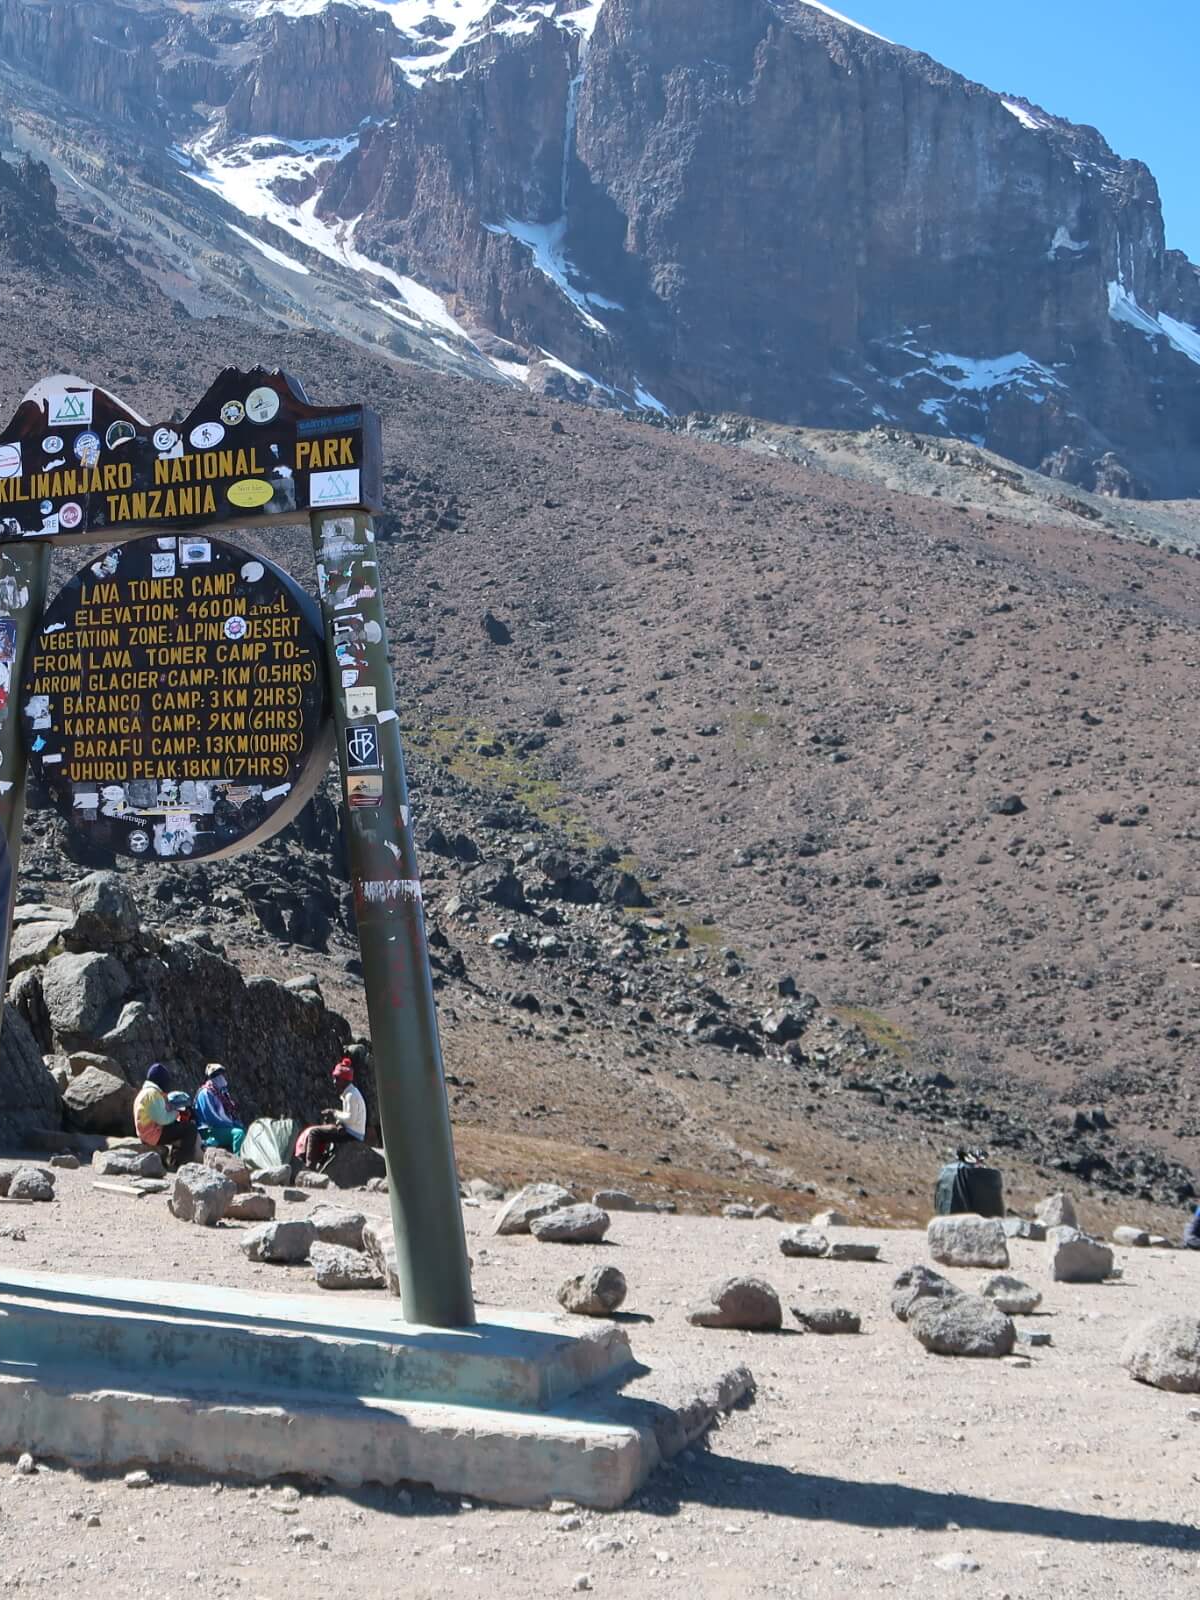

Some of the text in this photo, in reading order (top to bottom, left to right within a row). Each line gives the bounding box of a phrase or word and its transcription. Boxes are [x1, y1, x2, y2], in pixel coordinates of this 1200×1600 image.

[155, 448, 265, 485] NATIONAL
[296, 437, 354, 469] PARK
[107, 485, 216, 522] TANZANIA
[81, 573, 236, 605] LAVA TOWER CAMP
[75, 603, 179, 626] ELEVATION:
[187, 597, 247, 619] 4600M
[40, 617, 300, 651] VEGETATION ZONE: ALPINE DESERT
[33, 652, 81, 673] FROM
[89, 650, 132, 670] LAVA
[146, 645, 207, 666] TOWER
[216, 643, 266, 662] CAMP
[34, 660, 316, 694] ARROW GLACIER CAMP: 1KM (0.5HRS)
[63, 694, 140, 715] BARANCO
[152, 690, 205, 711] CAMP:
[64, 707, 303, 736] KARANGA CAMP: 9KM (6HRS)
[74, 738, 142, 758] BARAFU
[152, 737, 200, 756] CAMP:
[70, 761, 127, 781] UHURU
[224, 752, 289, 779] (17HRS)
